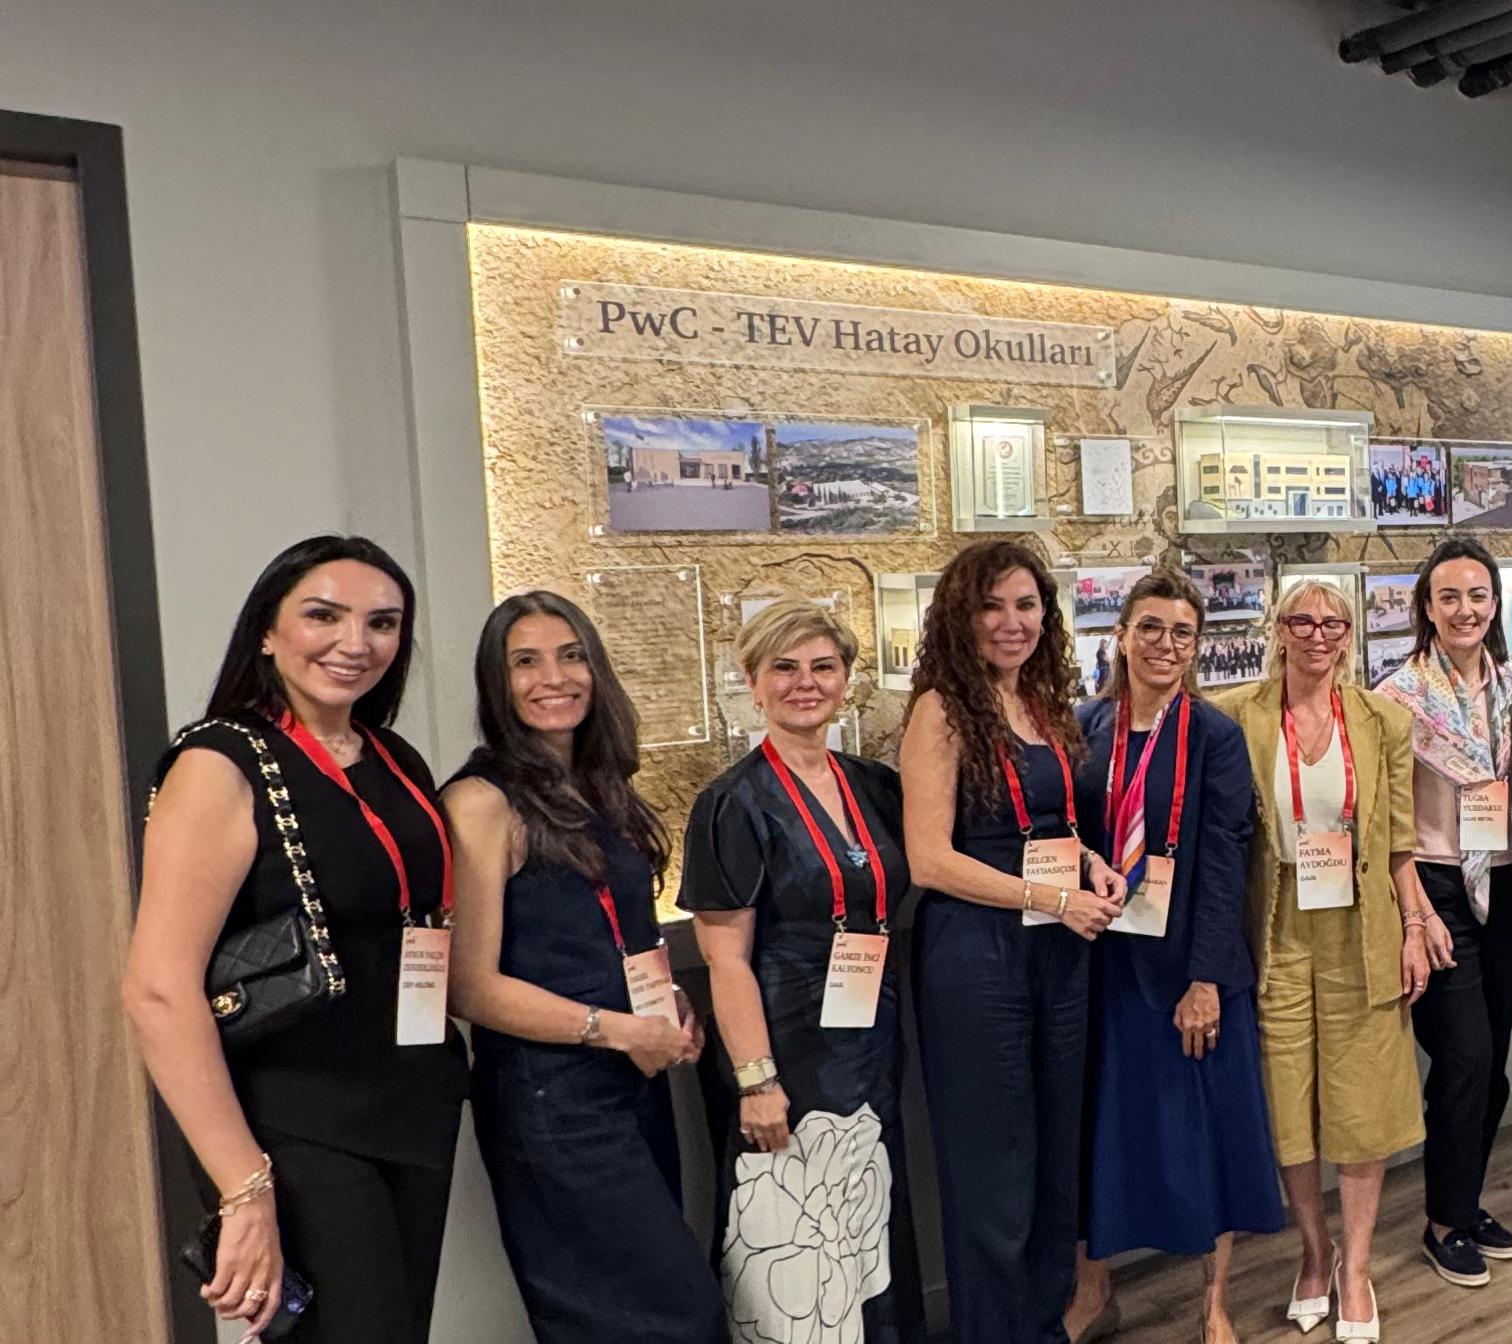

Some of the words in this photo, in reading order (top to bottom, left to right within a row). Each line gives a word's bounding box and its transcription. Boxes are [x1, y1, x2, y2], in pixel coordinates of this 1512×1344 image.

[596, 300, 698, 339] PwC
[736, 311, 821, 347] TEV
[830, 319, 945, 364] Hatay
[954, 328, 1094, 366] Okulları
[1299, 847, 1331, 858] FATMA
[1300, 858, 1347, 869] AYDOĞDU
